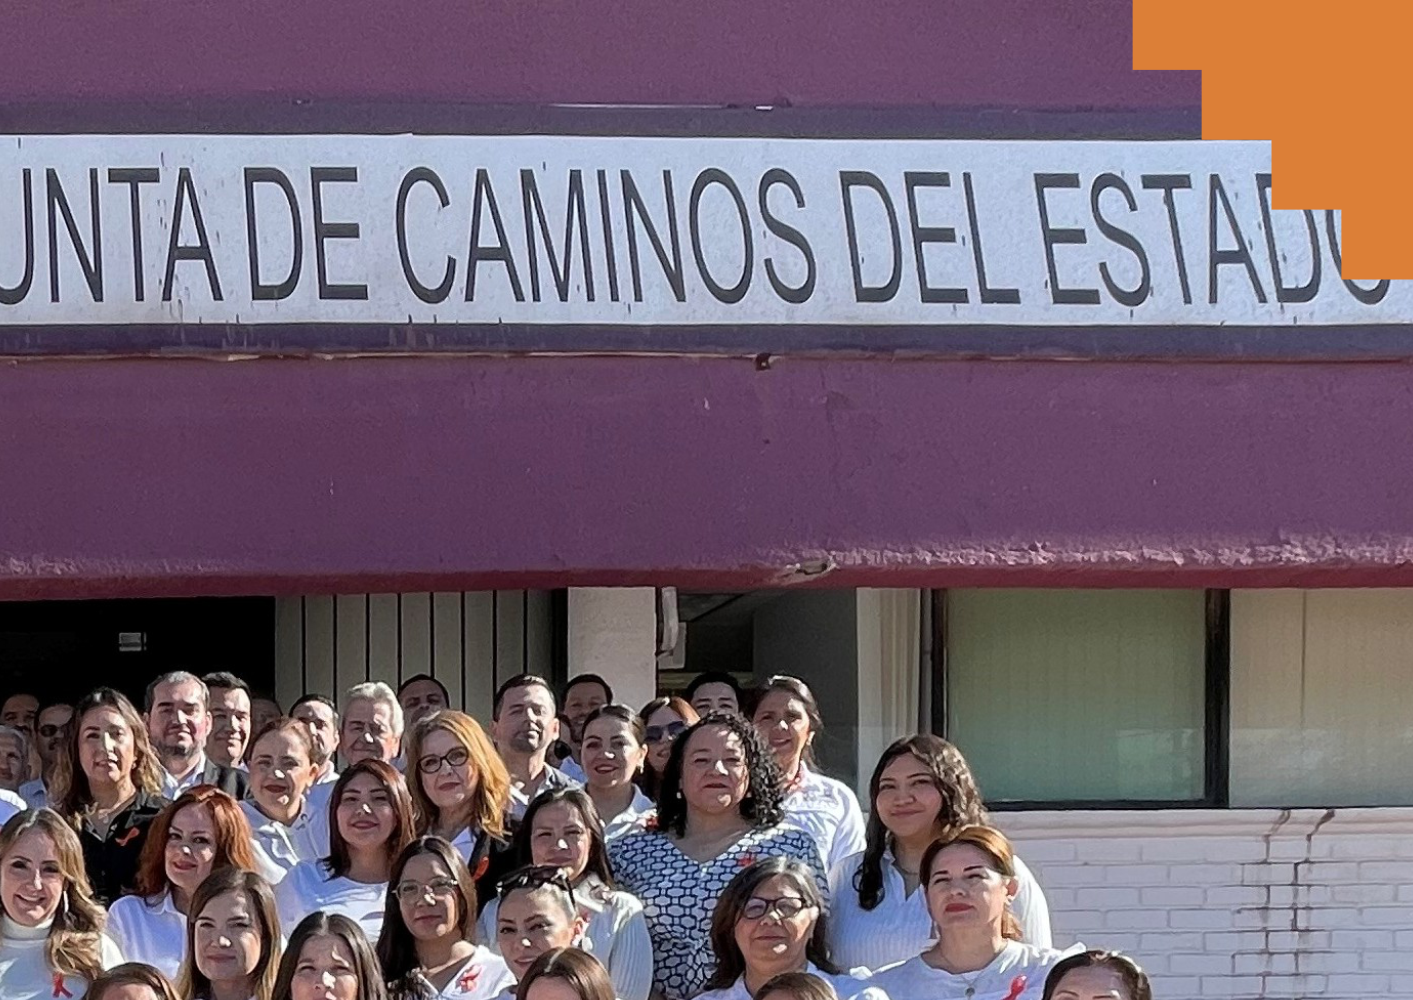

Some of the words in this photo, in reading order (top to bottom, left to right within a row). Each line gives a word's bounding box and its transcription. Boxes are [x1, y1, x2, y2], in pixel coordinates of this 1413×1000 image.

[244, 166, 369, 301] DE
[396, 166, 816, 305] CAMINOS
[839, 170, 1021, 305] DEL
